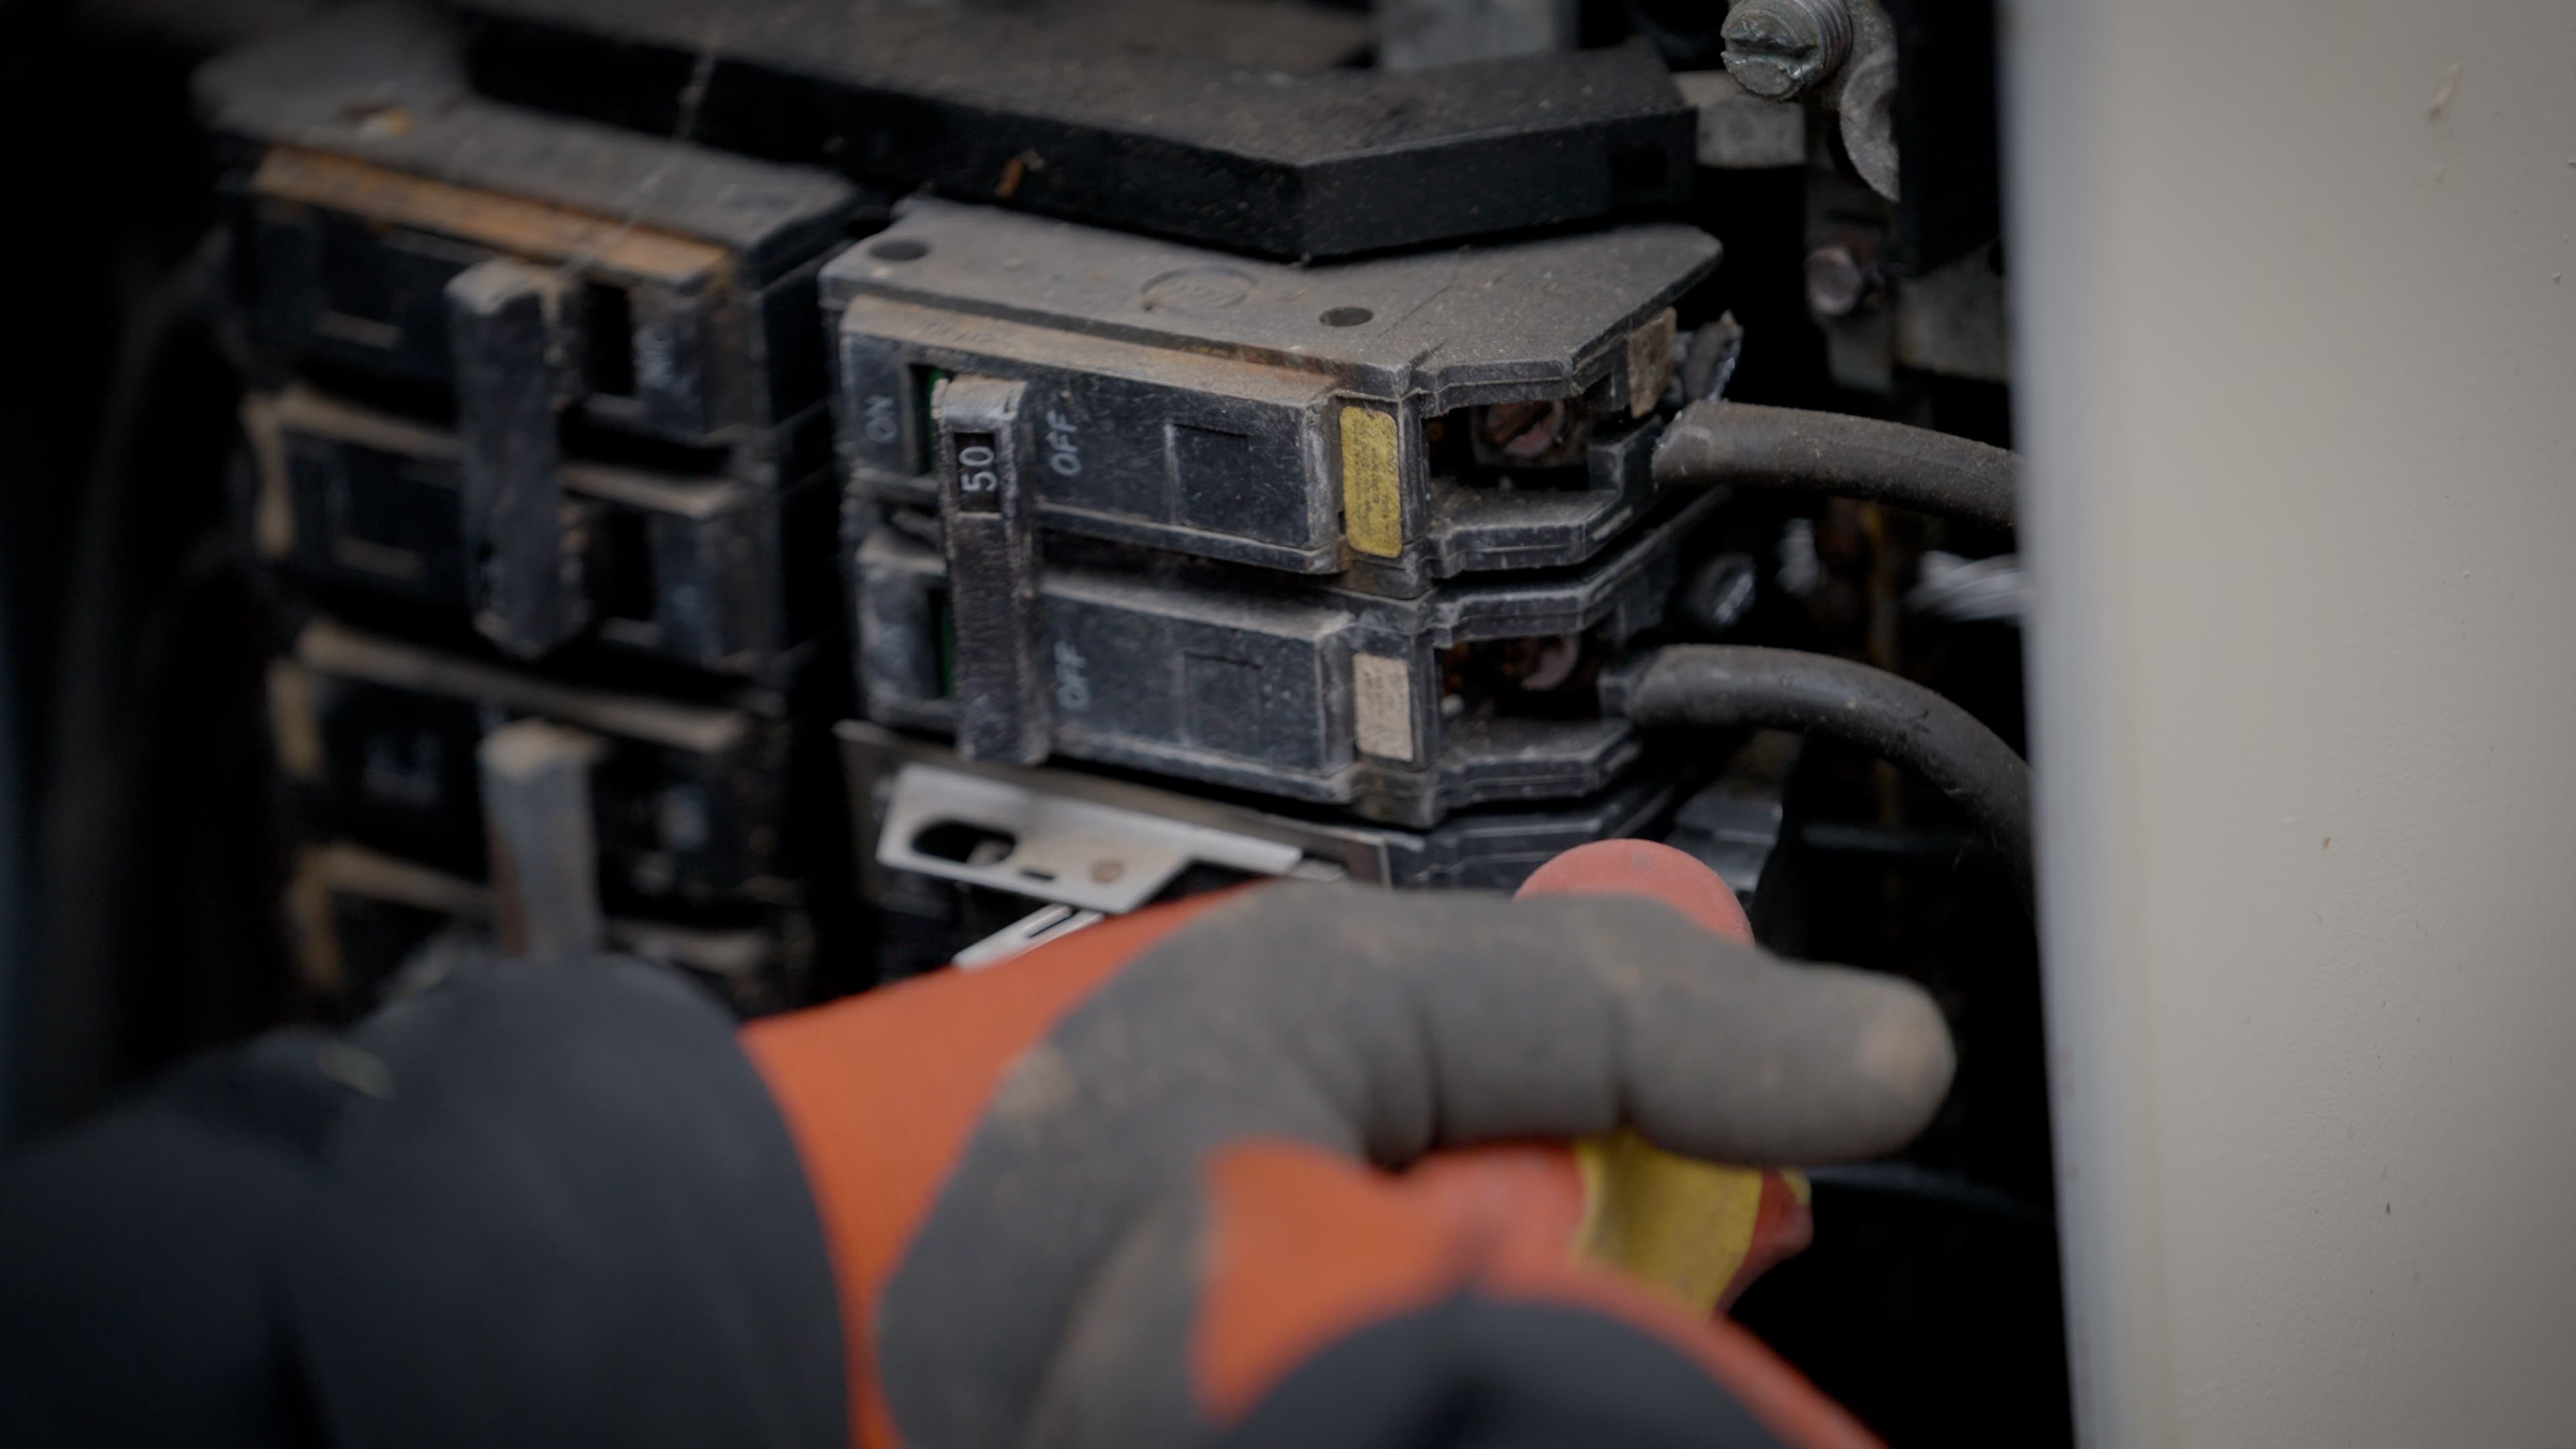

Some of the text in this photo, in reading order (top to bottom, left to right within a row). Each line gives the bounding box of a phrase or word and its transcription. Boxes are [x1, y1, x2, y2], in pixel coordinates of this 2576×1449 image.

[865, 396, 896, 443] ON
[1047, 410, 1081, 476] OFF
[959, 446, 998, 492] 50
[1055, 642, 1089, 712] OFF
